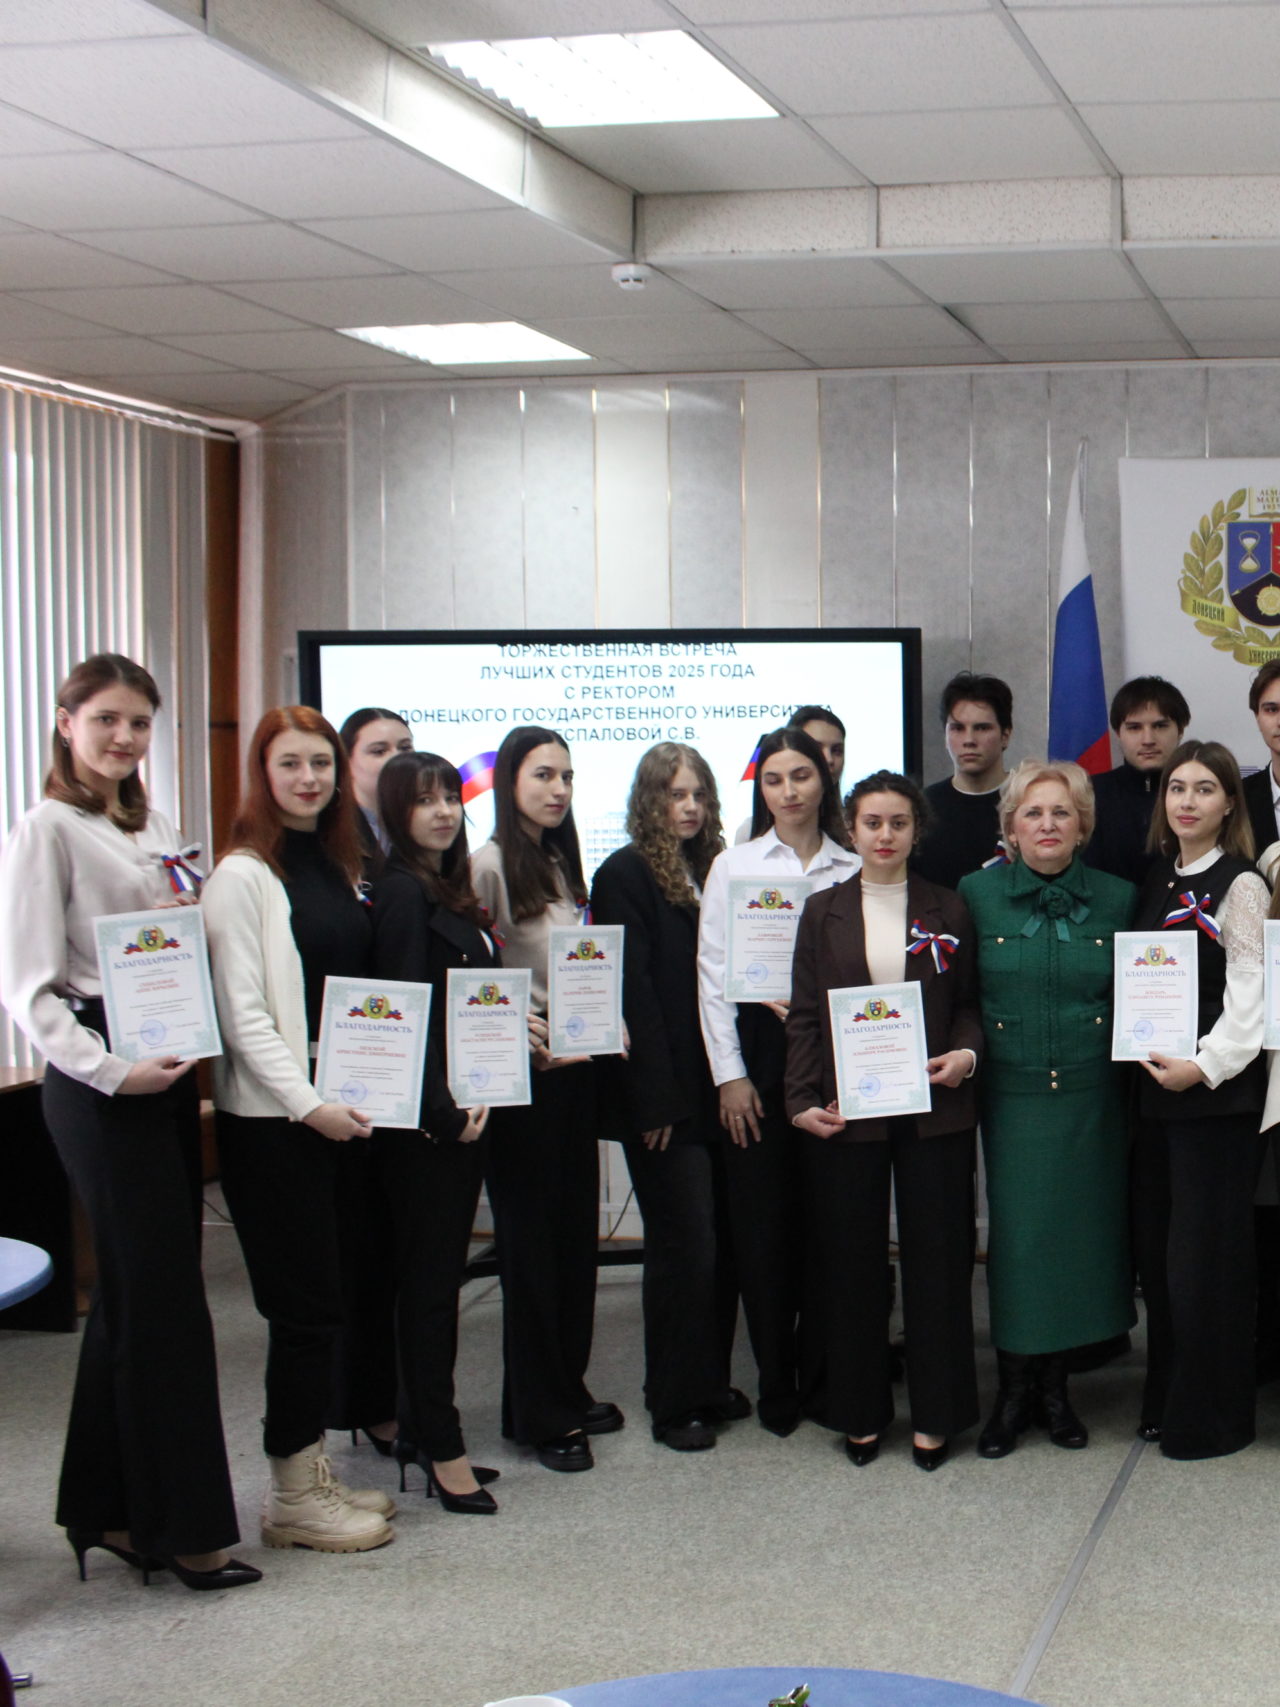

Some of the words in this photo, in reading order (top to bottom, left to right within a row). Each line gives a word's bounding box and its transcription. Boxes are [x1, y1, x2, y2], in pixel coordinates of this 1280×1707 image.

[500, 643, 653, 658] ТОРЖЕСТВЕННАЯ
[659, 642, 738, 657] ВСТРЕЧА
[480, 665, 556, 680] ЛУЧШИХ
[561, 664, 663, 680] СТУДЕНТОВ
[668, 664, 705, 678] 2025
[710, 664, 755, 679] ГОДА
[564, 686, 576, 700] С
[581, 685, 675, 700] РЕКТОРОМ
[398, 708, 507, 724] ДОНЕЦКОГО
[513, 705, 697, 722] ГОСУДАРСТВЕННОГО
[552, 725, 662, 742] СПАЛОВОЙ
[667, 726, 700, 741] С.В.
[737, 913, 801, 921] БЛАГОДАРНОСТ
[335, 1021, 413, 1034] БЛАГОДАРНОСТЬ
[844, 1022, 912, 1034] БЛАГОДАРНОСТЬ
